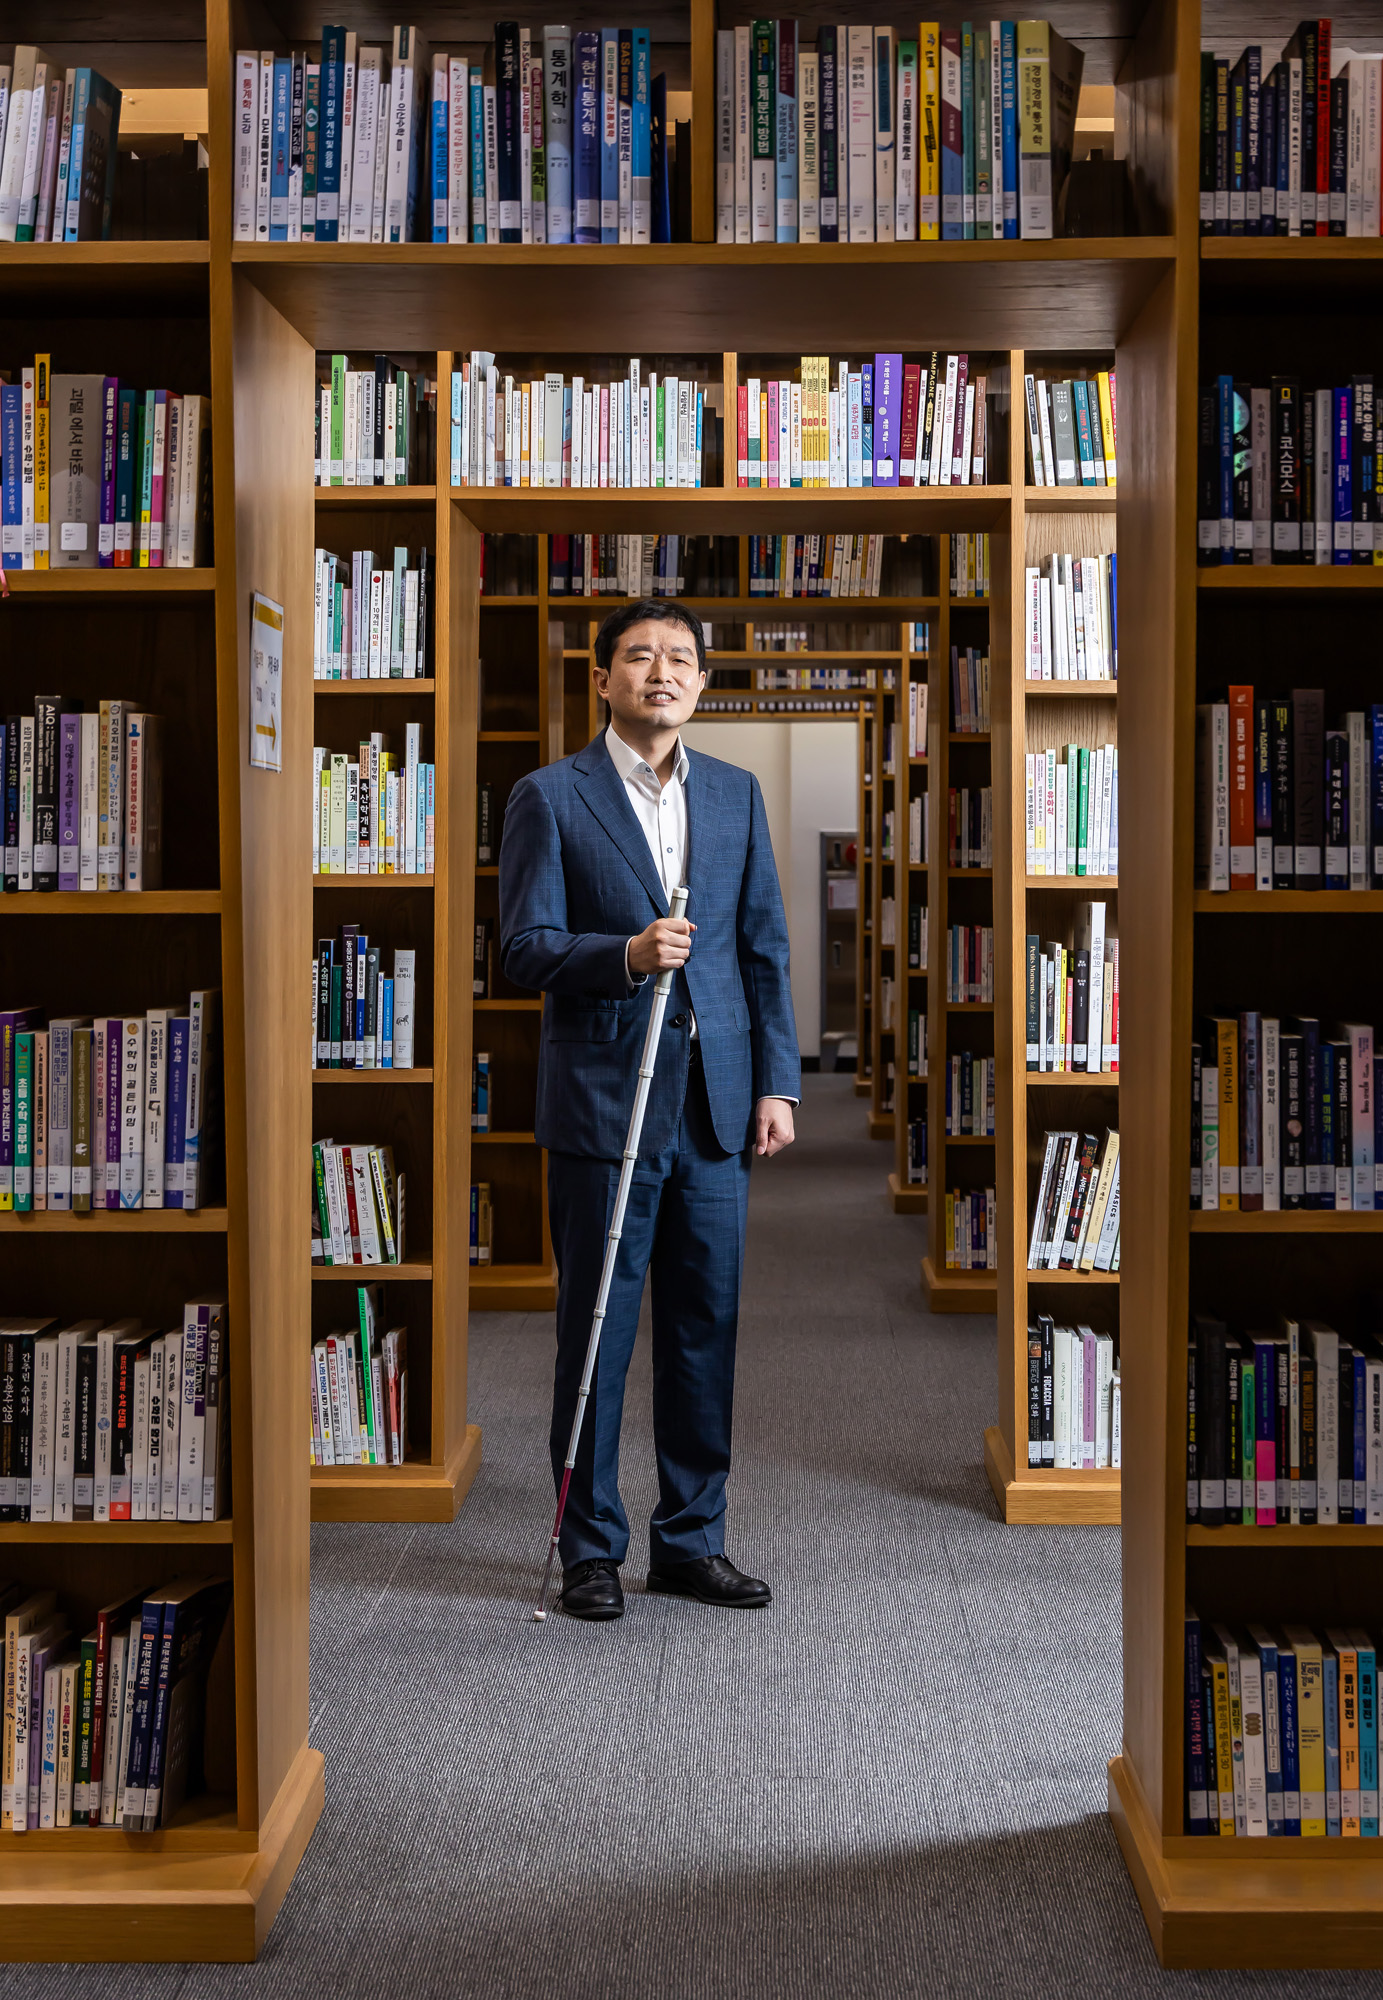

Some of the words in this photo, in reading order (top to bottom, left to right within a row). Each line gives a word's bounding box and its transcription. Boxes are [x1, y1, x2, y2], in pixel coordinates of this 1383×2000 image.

[1004, 33, 1014, 58] 시계열
[550, 49, 567, 108] 통계학
[1004, 61, 1014, 77] 분석
[243, 79, 252, 109] 통계학
[1004, 81, 1014, 89] 및
[582, 60, 596, 137] 현대통계학
[1004, 93, 1014, 109] 응용
[242, 114, 251, 134] 도감
[395, 103, 407, 137] 이산수학
[607, 97, 615, 137] 기초통계학
[620, 109, 630, 162] 통계자료분석
[884, 367, 889, 377] 와인
[69, 388, 84, 416] 괴델,
[68, 417, 83, 447] 에셔,
[1363, 414, 1373, 442] 아쿠아
[69, 449, 83, 477] 바흐
[45, 705, 56, 730] AIQ:
[1278, 775, 1287, 793] 우주
[360, 783, 369, 837] 축산학개론
[43, 812, 53, 839] 수학의
[1093, 937, 1102, 968] 대통령의
[1092, 972, 1101, 987] 식탁
[174, 1032, 182, 1046] 기초
[127, 1038, 137, 1072] 수학의
[173, 1048, 182, 1063] 수학
[149, 1071, 158, 1095] 가이드
[126, 1079, 137, 1128] 골든타임
[1110, 1190, 1120, 1218] BASICS
[187, 1324, 196, 1348] 어떻게
[197, 1324, 207, 1349] How
[197, 1350, 206, 1361] to
[195, 1363, 206, 1393] Prove
[320, 1363, 325, 1375] 나의
[1303, 1370, 1314, 1382] THE
[119, 1394, 126, 1407] 수학
[184, 1380, 195, 1405] 것인가
[321, 1395, 328, 1406] 내가
[1043, 1375, 1052, 1406] FOCACCIA
[1303, 1384, 1314, 1409] WORLD
[62, 1399, 71, 1421] 수학의
[151, 1396, 160, 1424] 수학은
[1303, 1410, 1314, 1432] ITSELF
[62, 1424, 70, 1438] 모험
[151, 1429, 160, 1457] 암기다
[96, 1662, 104, 1677] TAO
[140, 1641, 153, 1685] 미분적분학
[95, 1679, 103, 1698] 해석학
[1217, 1685, 1226, 1702] 세계
[1217, 1705, 1227, 1729] 물리학
[1218, 1732, 1227, 1756] 필독서
[1220, 1758, 1229, 1769] 30
